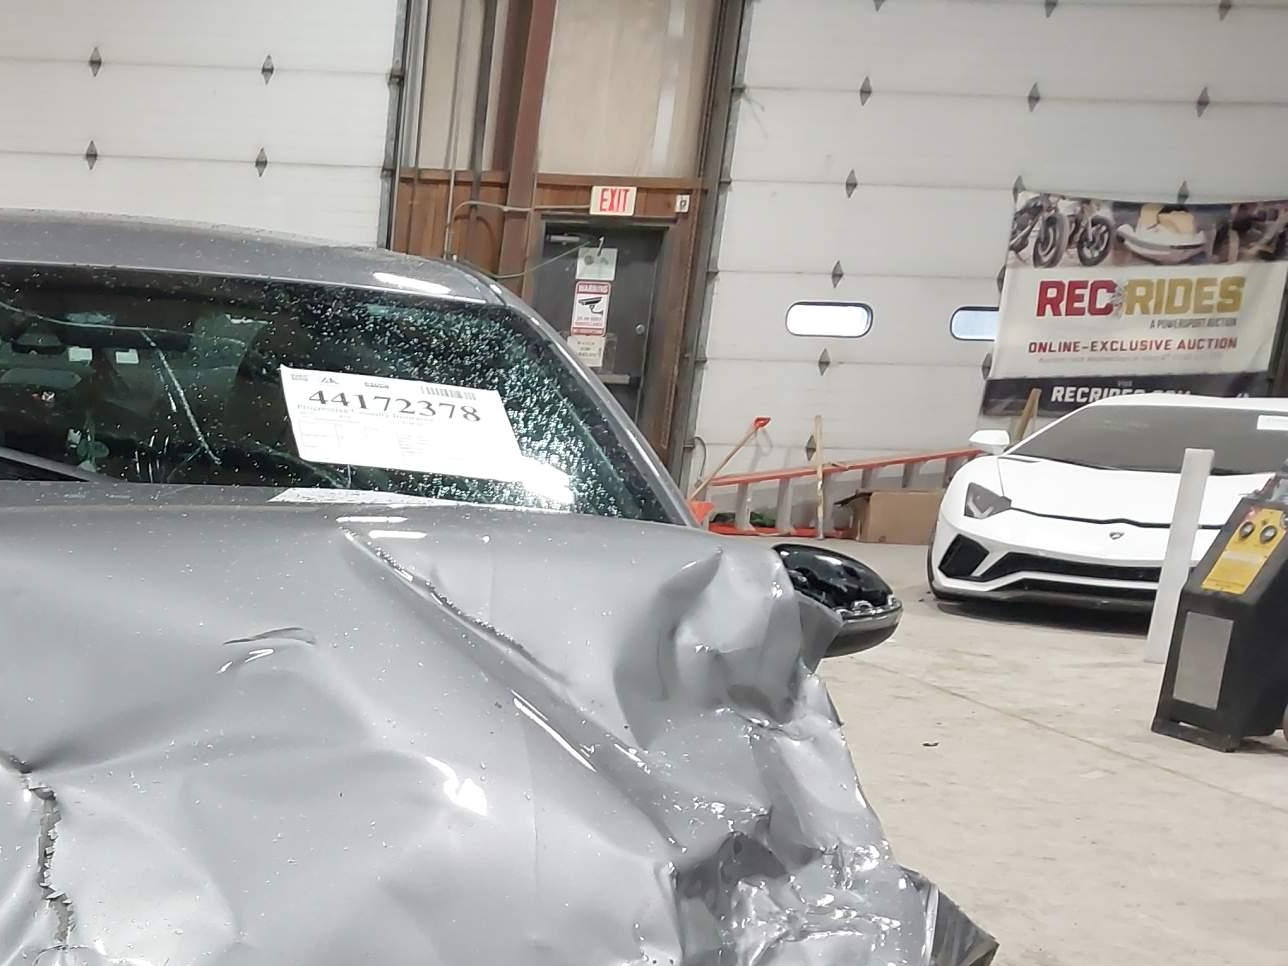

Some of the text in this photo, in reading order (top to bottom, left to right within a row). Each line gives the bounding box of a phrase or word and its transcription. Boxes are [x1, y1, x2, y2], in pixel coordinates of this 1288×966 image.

[599, 187, 630, 213] EXIT
[1036, 277, 1246, 317] REC RIDES
[1028, 336, 1238, 354] ONLINE-EXCLUSIVE AUCTION
[308, 389, 481, 422] 44172378
